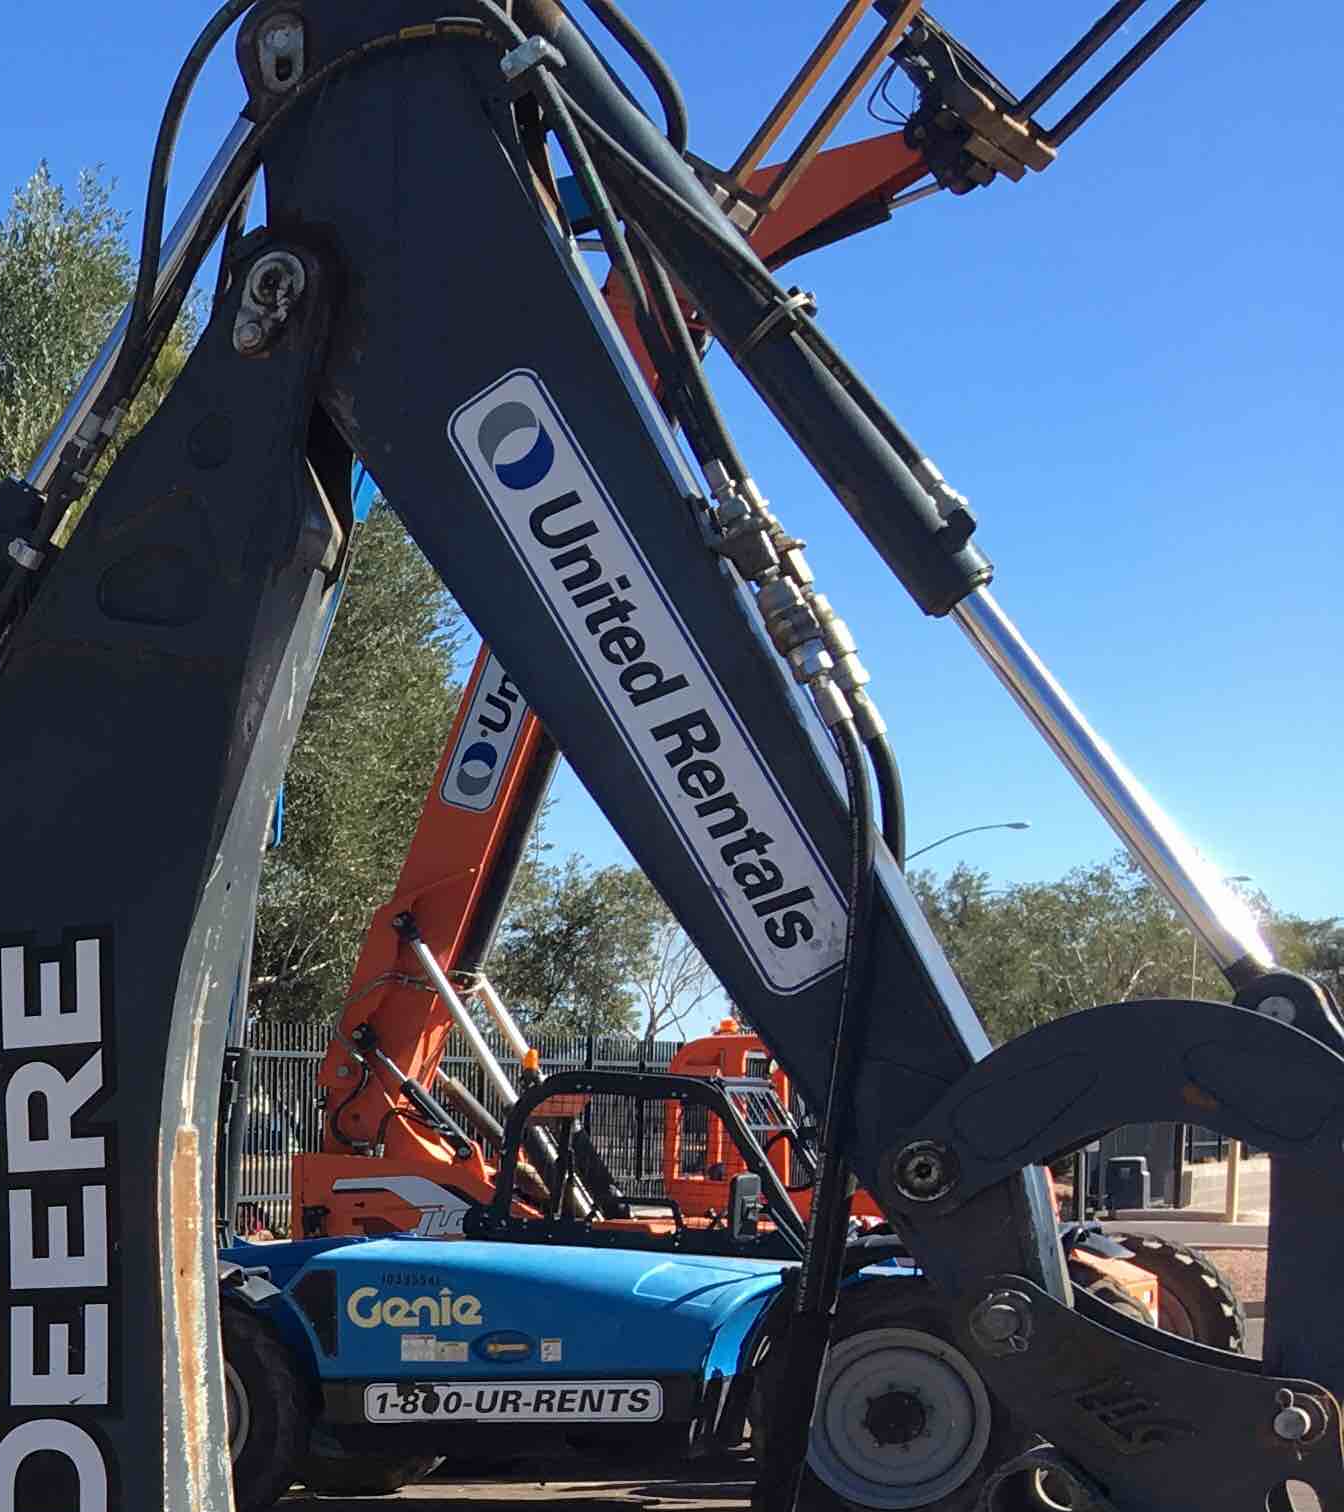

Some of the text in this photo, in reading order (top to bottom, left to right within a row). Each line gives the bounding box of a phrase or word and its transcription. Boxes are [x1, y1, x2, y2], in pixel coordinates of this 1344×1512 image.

[529, 490, 815, 951] United Rentals
[347, 1286, 483, 1328] Genie
